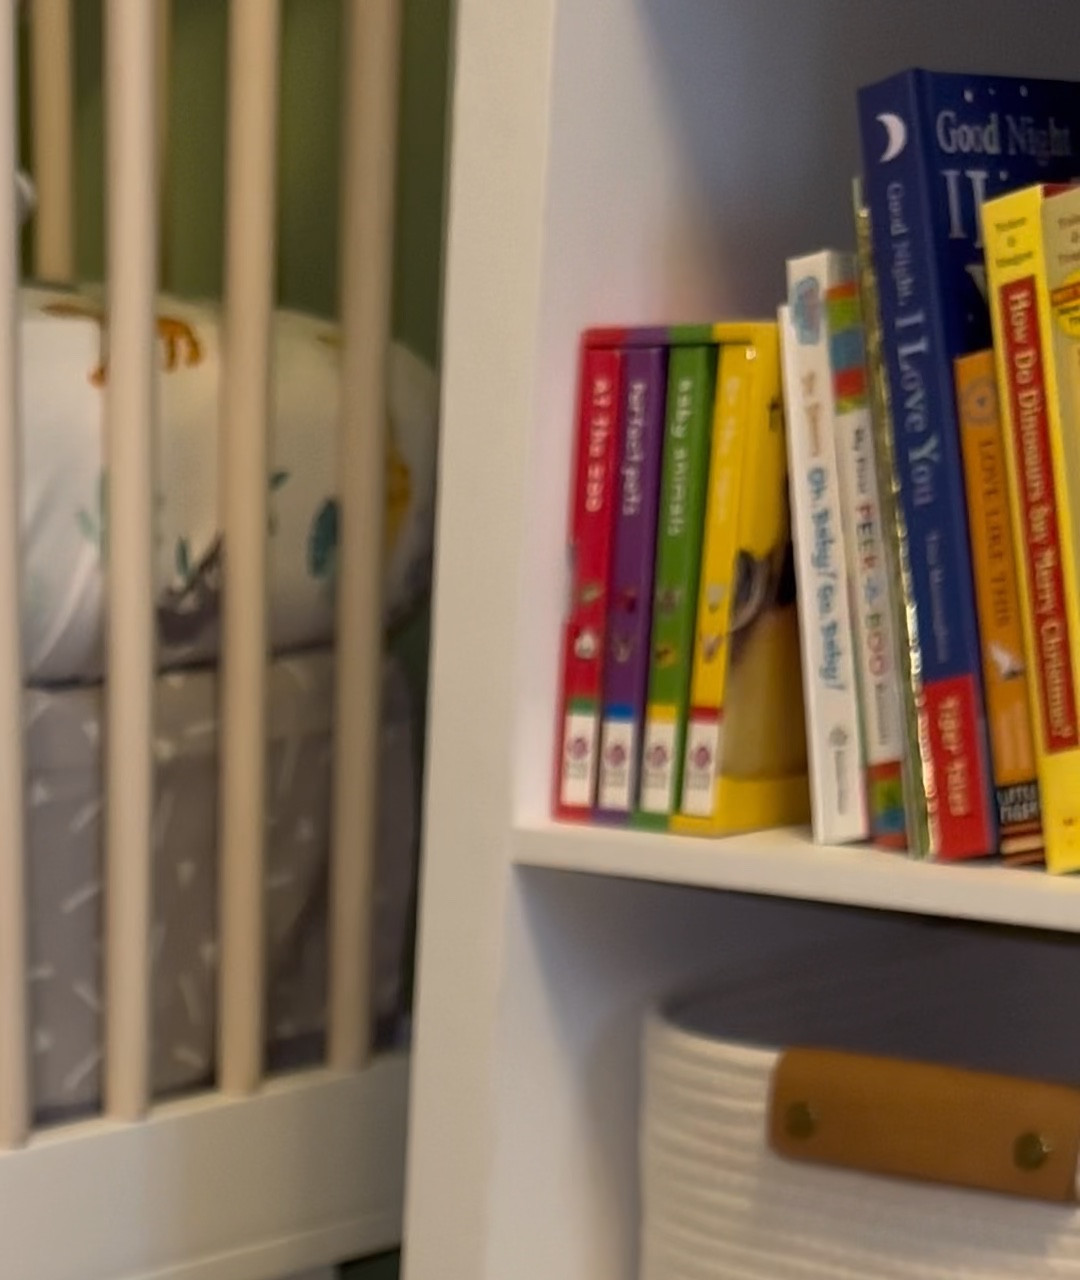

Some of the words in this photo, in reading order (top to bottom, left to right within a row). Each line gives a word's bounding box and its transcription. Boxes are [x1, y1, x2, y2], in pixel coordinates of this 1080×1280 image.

[936, 110, 1001, 155] Good
[886, 182, 909, 237] Good
[894, 311, 924, 329] I
[1009, 289, 1033, 345] How
[897, 336, 929, 433] Love
[1014, 348, 1038, 385] Do
[908, 434, 941, 507] You
[1018, 389, 1047, 503] Dinosaurs
[1028, 504, 1053, 546] Say
[1034, 547, 1058, 616] Merry
[1040, 616, 1074, 740] Christmas?
